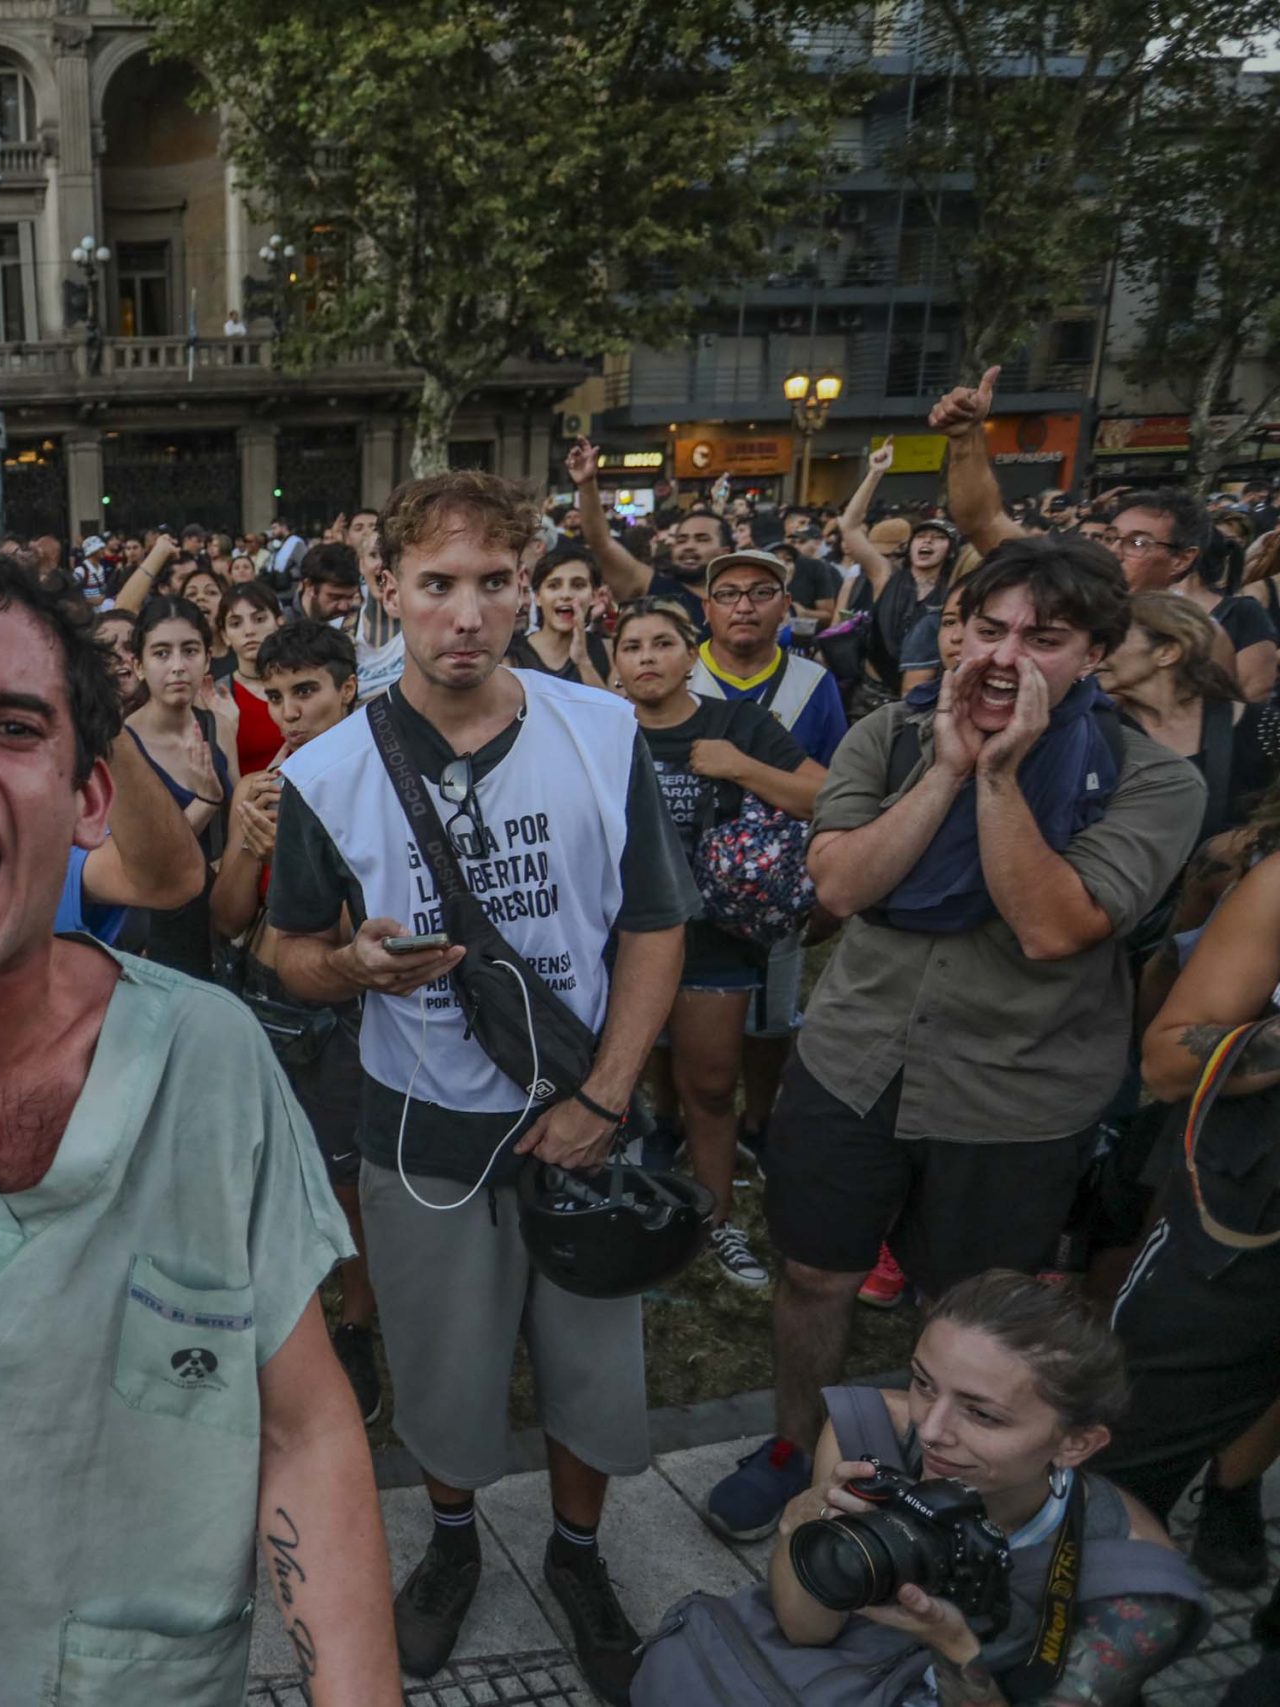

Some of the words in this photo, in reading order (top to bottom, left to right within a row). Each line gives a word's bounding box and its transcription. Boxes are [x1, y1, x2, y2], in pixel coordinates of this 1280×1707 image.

[995, 452, 1064, 464] EMPANADAS
[504, 812, 550, 848] POR
[466, 851, 549, 894] IBERTAD
[426, 997, 450, 1010] POR
[904, 1494, 935, 1518] Nikon
[1040, 1601, 1066, 1665] Nikon
